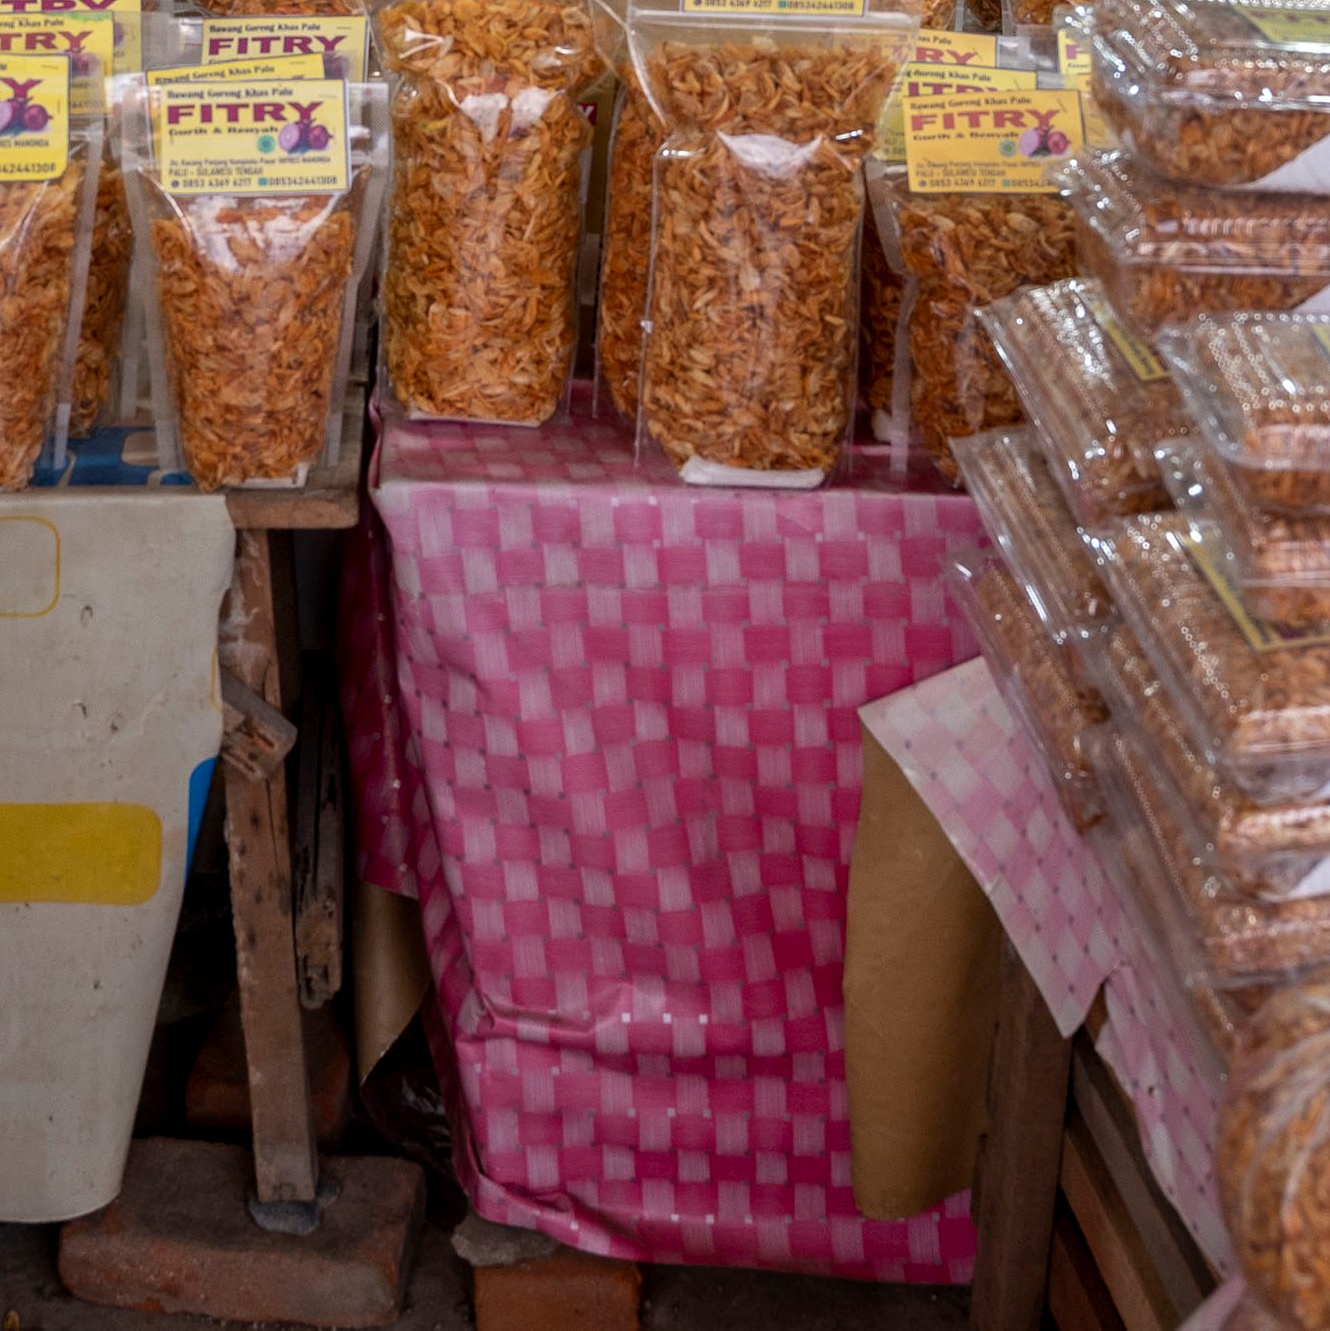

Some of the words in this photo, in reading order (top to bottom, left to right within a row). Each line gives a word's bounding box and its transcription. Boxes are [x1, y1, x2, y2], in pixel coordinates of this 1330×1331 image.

[209, 25, 242, 34] Bawang
[245, 24, 275, 33] Goreng
[278, 23, 299, 31] Khas
[302, 23, 321, 31] Palu
[208, 35, 348, 55] FITRY
[167, 101, 324, 125] FITRY
[912, 108, 1062, 132] FITRY
